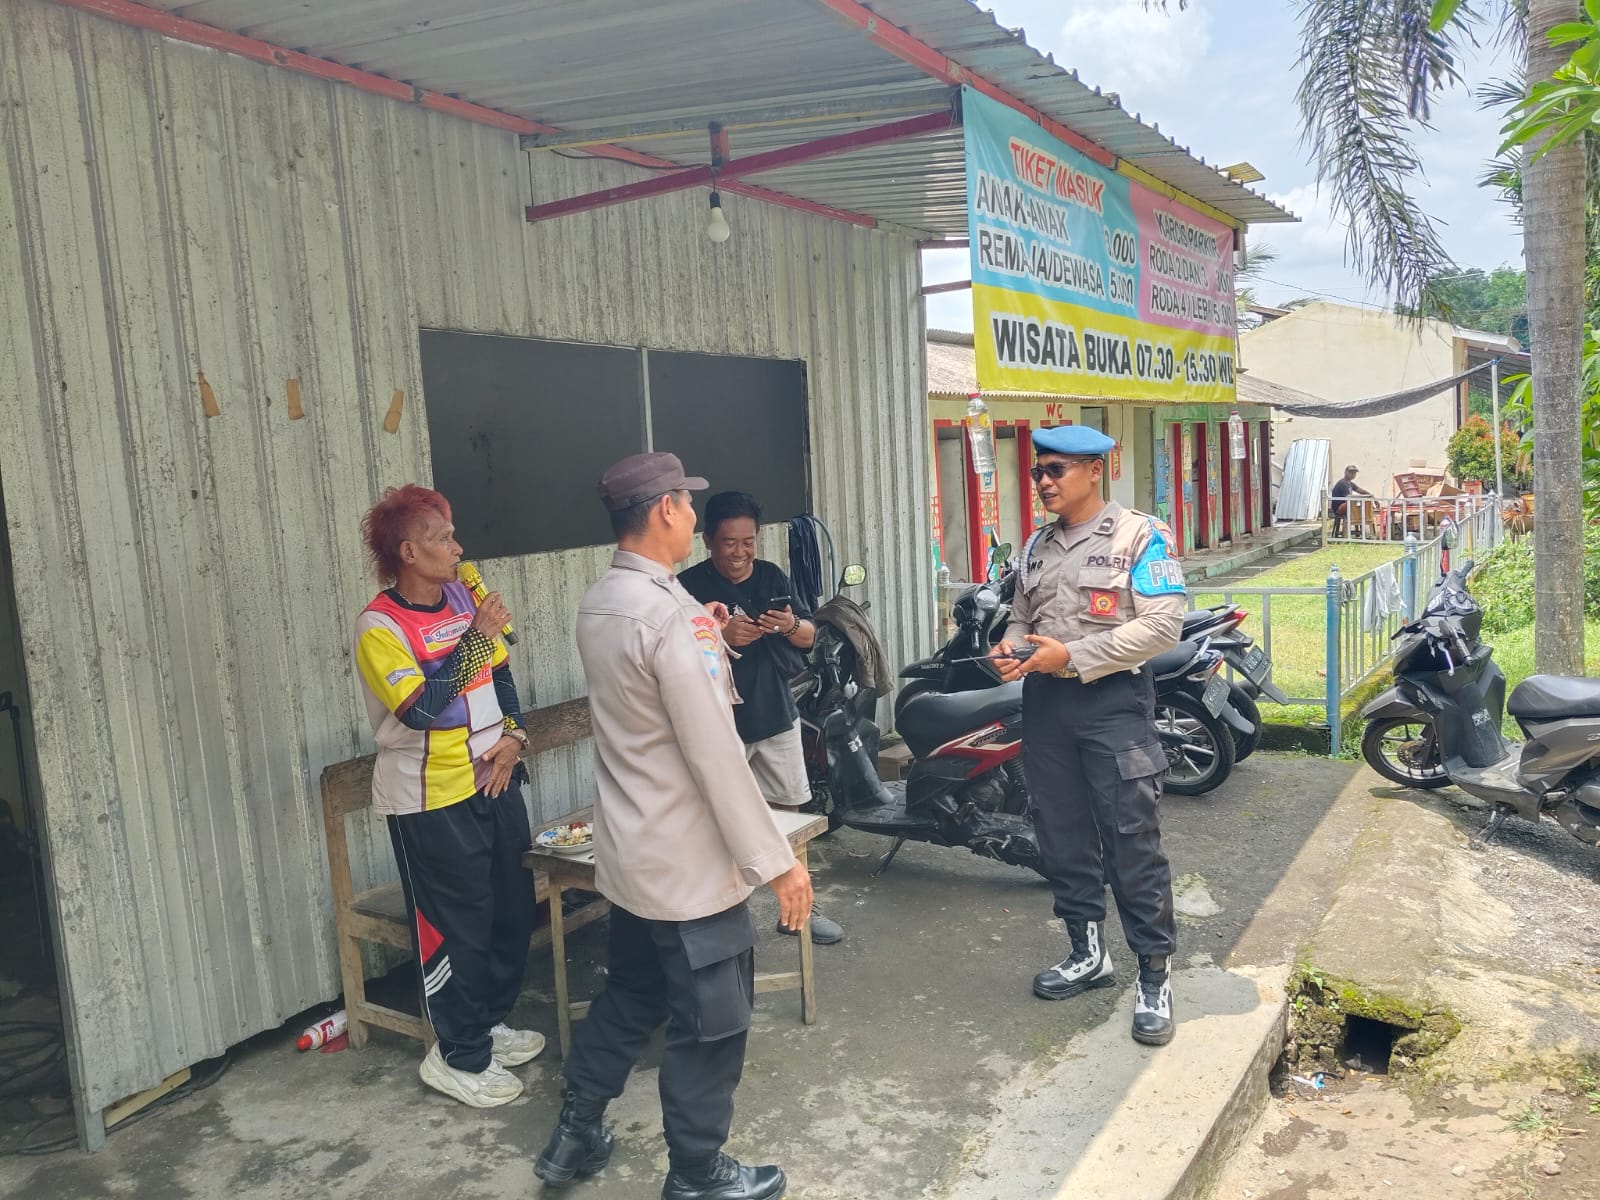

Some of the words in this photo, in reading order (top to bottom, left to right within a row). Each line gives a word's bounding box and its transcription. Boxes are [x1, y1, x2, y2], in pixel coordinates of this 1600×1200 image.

[1010, 142, 1056, 189] TIKET
[1055, 165, 1104, 213] MASUK
[976, 175, 1070, 242] ANAK-ANAK
[1149, 244, 1176, 279] RODA
[1175, 255, 1182, 280] 2
[1182, 258, 1202, 288] DAN
[1151, 284, 1180, 315] RODA
[992, 317, 1082, 370] WISATA
[1083, 332, 1133, 376] BUKA
[1135, 343, 1174, 380] 07.30
[1183, 351, 1217, 383] 15.30
[1045, 402, 1063, 419] WC
[1087, 555, 1127, 569] POLRI
